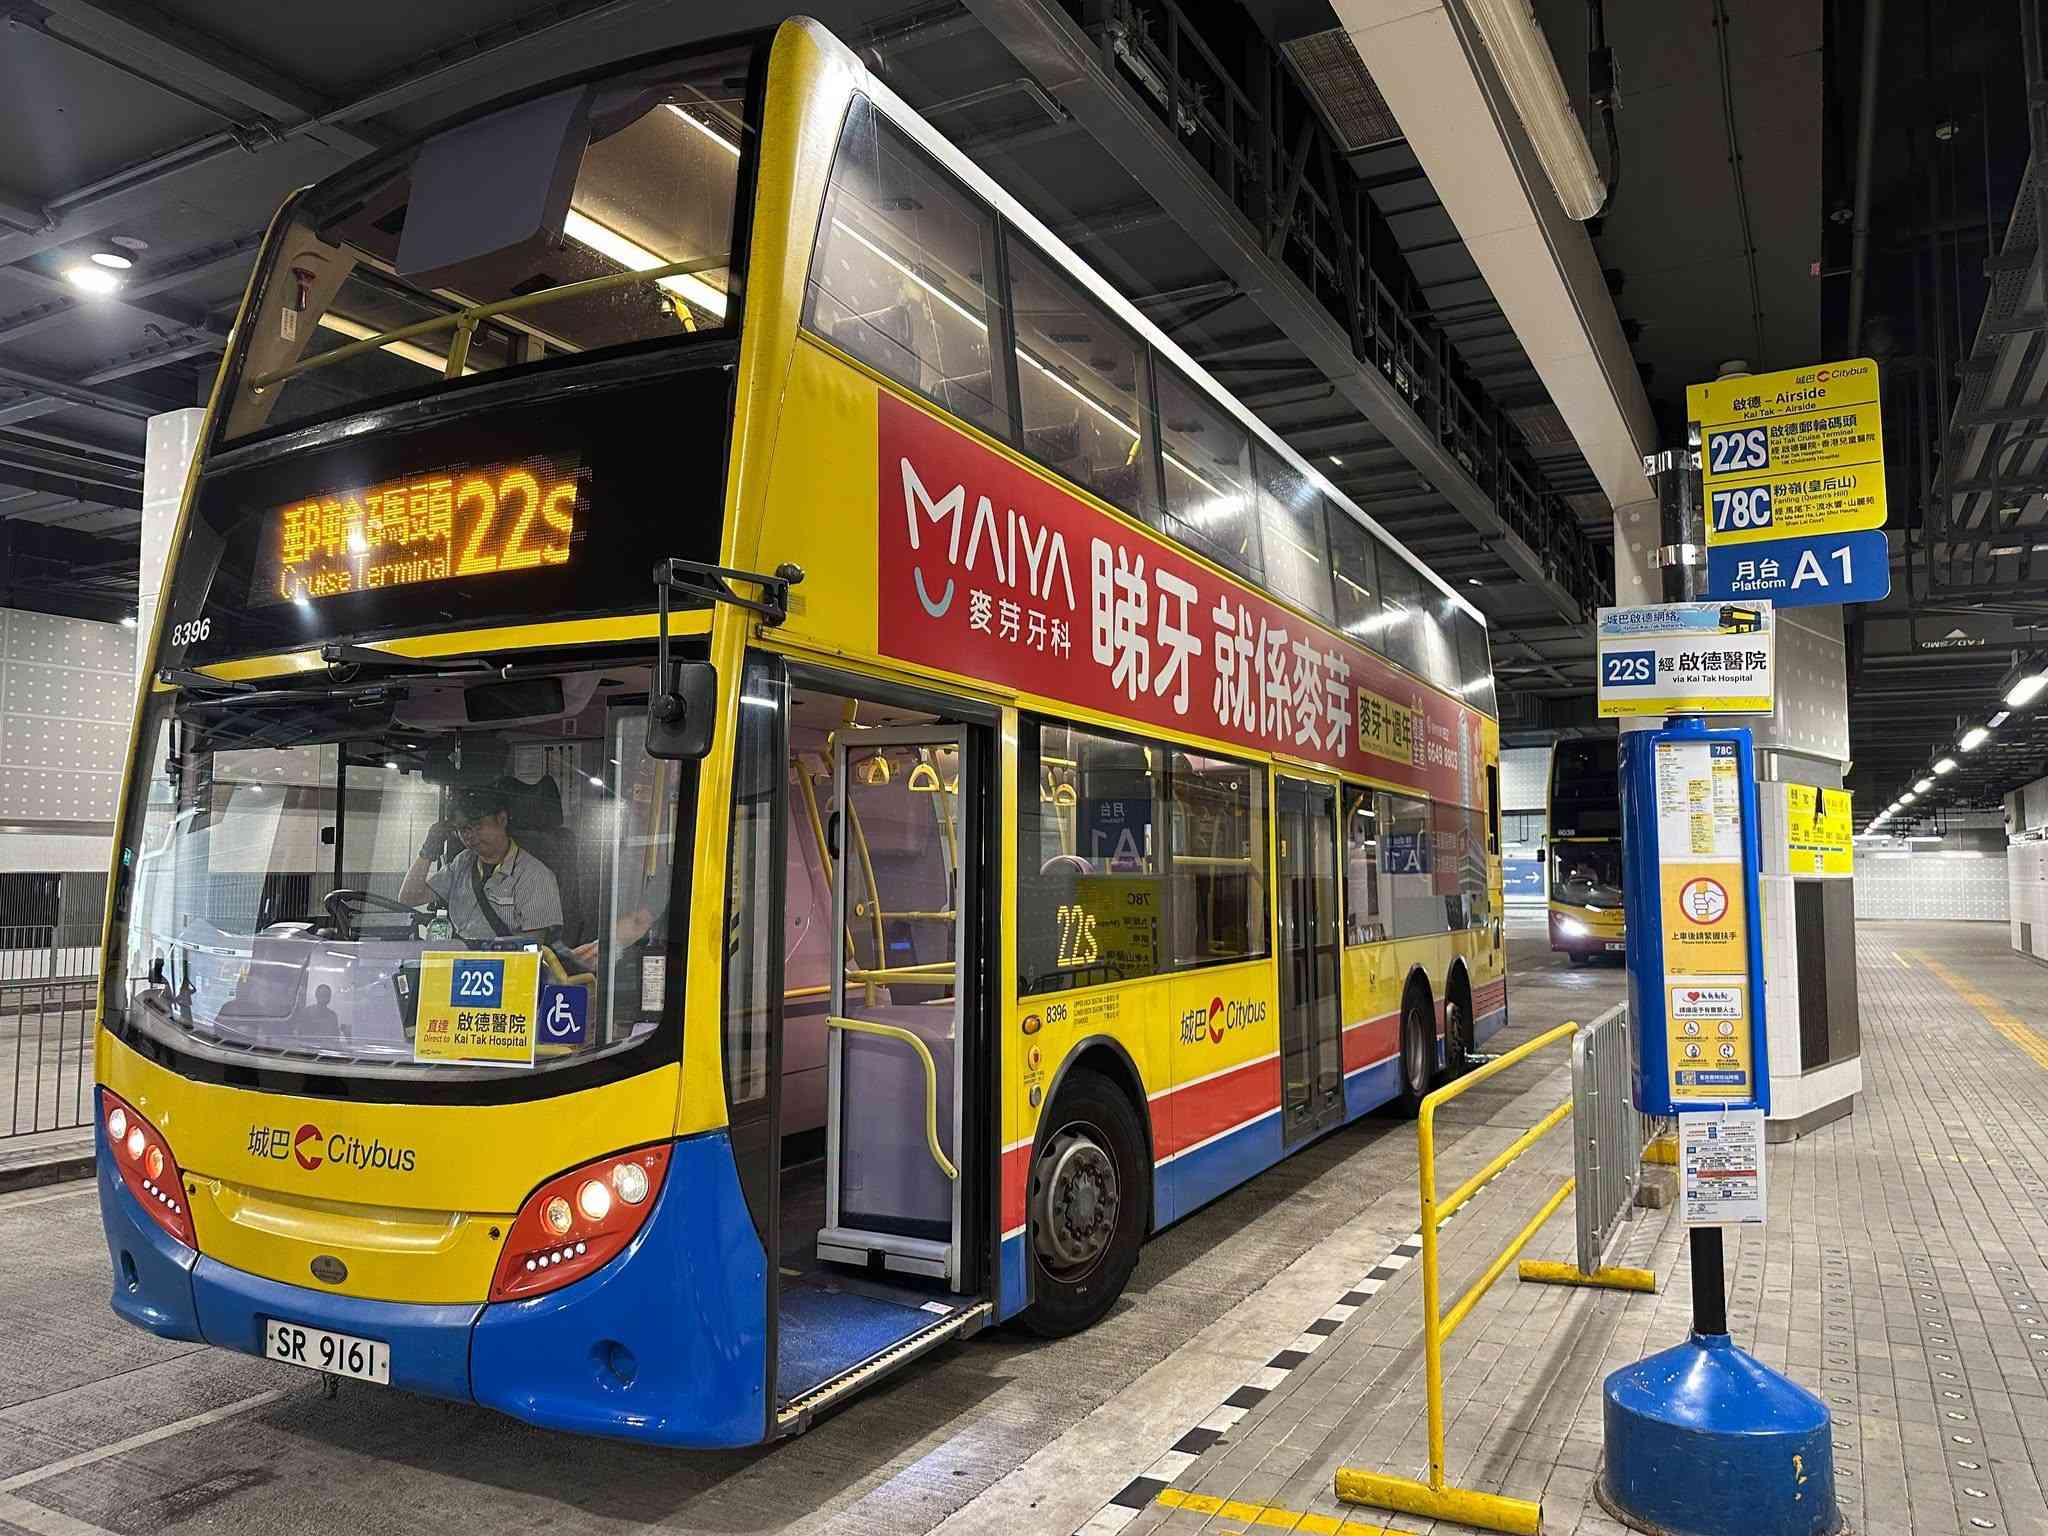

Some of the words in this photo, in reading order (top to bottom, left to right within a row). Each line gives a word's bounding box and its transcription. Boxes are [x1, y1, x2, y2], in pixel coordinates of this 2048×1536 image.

[1831, 367, 1869, 379] Citybus
[1775, 387, 1826, 405] Airside
[1743, 409, 1758, 420] Kai
[1760, 407, 1775, 417] Tak
[1785, 402, 1816, 414] Airside
[1771, 437, 1782, 446] Kai
[1797, 434, 1820, 442] Cruise
[1822, 429, 1854, 439] Terminal
[1711, 429, 1768, 473] 22S
[1713, 487, 1771, 531] 78C
[1774, 495, 1800, 505] Fanling
[282, 479, 452, 565] 郵輪碼頭
[901, 457, 1076, 612] MAIYA
[280, 563, 352, 601] Cruise
[352, 545, 451, 589] Terminal
[1736, 559, 1780, 581] 月台
[1790, 545, 1853, 590] A1
[1731, 576, 1786, 594] Platform
[172, 617, 211, 647] 8396
[968, 588, 1072, 661] 麥芽牙科
[1091, 536, 1202, 715] 睇牙
[1212, 593, 1352, 758] 就係麥芽
[1608, 657, 1650, 682] 22S
[1658, 657, 1675, 672] 經
[1679, 650, 1767, 672] 啟德醫院
[1672, 676, 1685, 684] via
[1687, 675, 1700, 683] Kai
[1703, 674, 1717, 683] Tak
[1718, 674, 1753, 684] Hospital
[1715, 746, 1732, 756] 78C
[460, 970, 495, 997] 22S
[457, 1011, 526, 1034] 啟德醫院
[1046, 1003, 1067, 1024] 8396
[1180, 1007, 1207, 1046] 城巴
[1225, 999, 1267, 1031] Citybus
[454, 1033, 469, 1045] Kai
[471, 1033, 487, 1046] Tak
[489, 1035, 527, 1049] Hospital
[247, 1124, 291, 1161] 城巴
[327, 1133, 417, 1172] Citybus
[276, 1325, 308, 1363] SR
[319, 1334, 375, 1378] 9161
